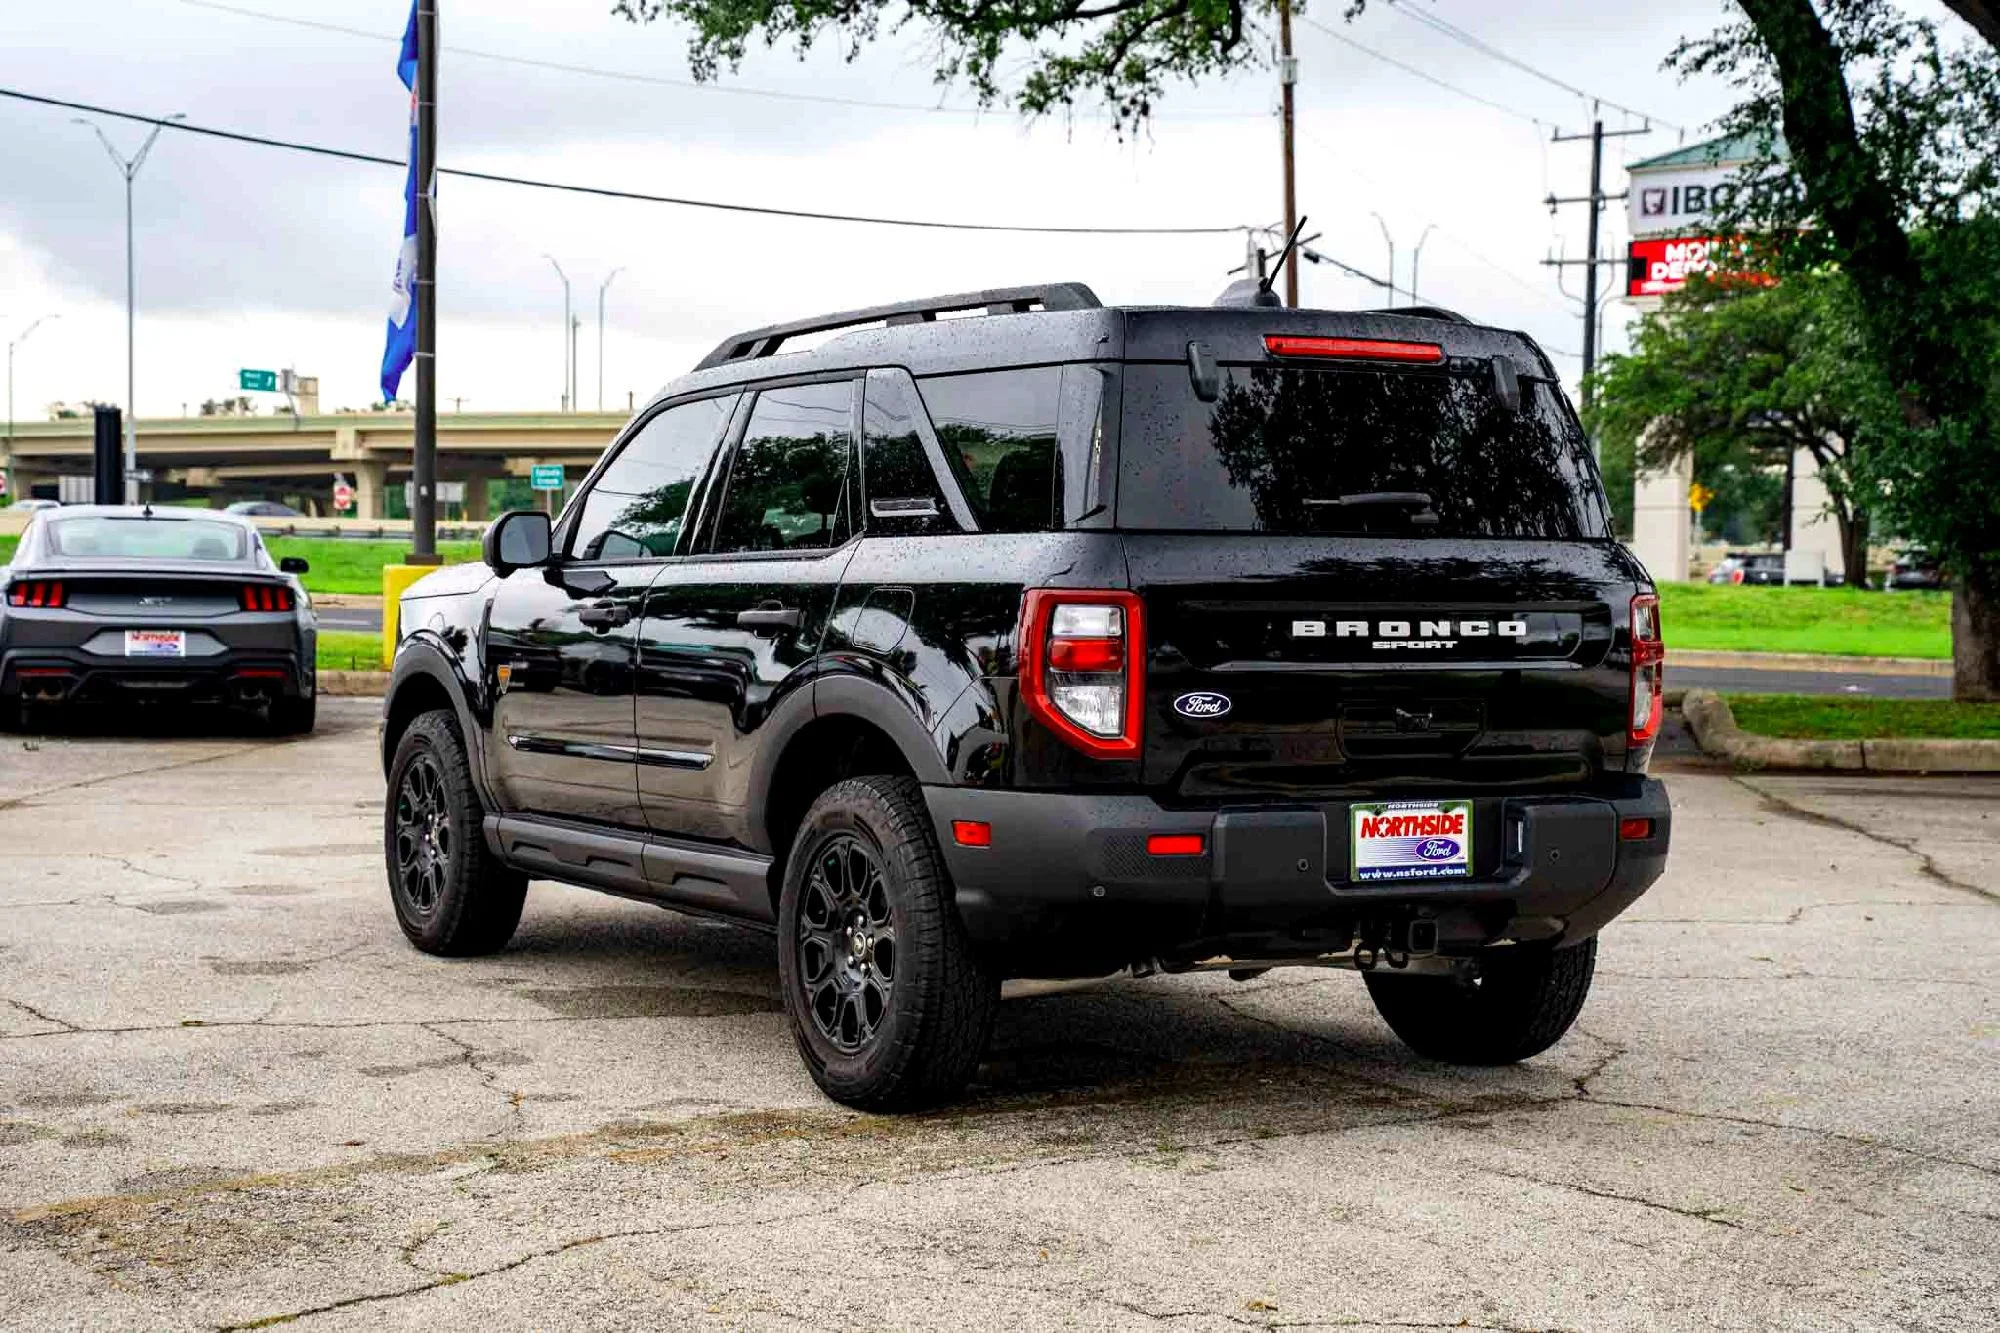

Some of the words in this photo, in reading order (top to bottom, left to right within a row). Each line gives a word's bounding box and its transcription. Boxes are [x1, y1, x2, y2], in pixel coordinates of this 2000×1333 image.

[1292, 621, 1527, 637] BRONCO
[1372, 641, 1458, 649] SPORT
[1361, 814, 1464, 838] NORTHSIDE
[1360, 866, 1466, 880] www.nsford.com
